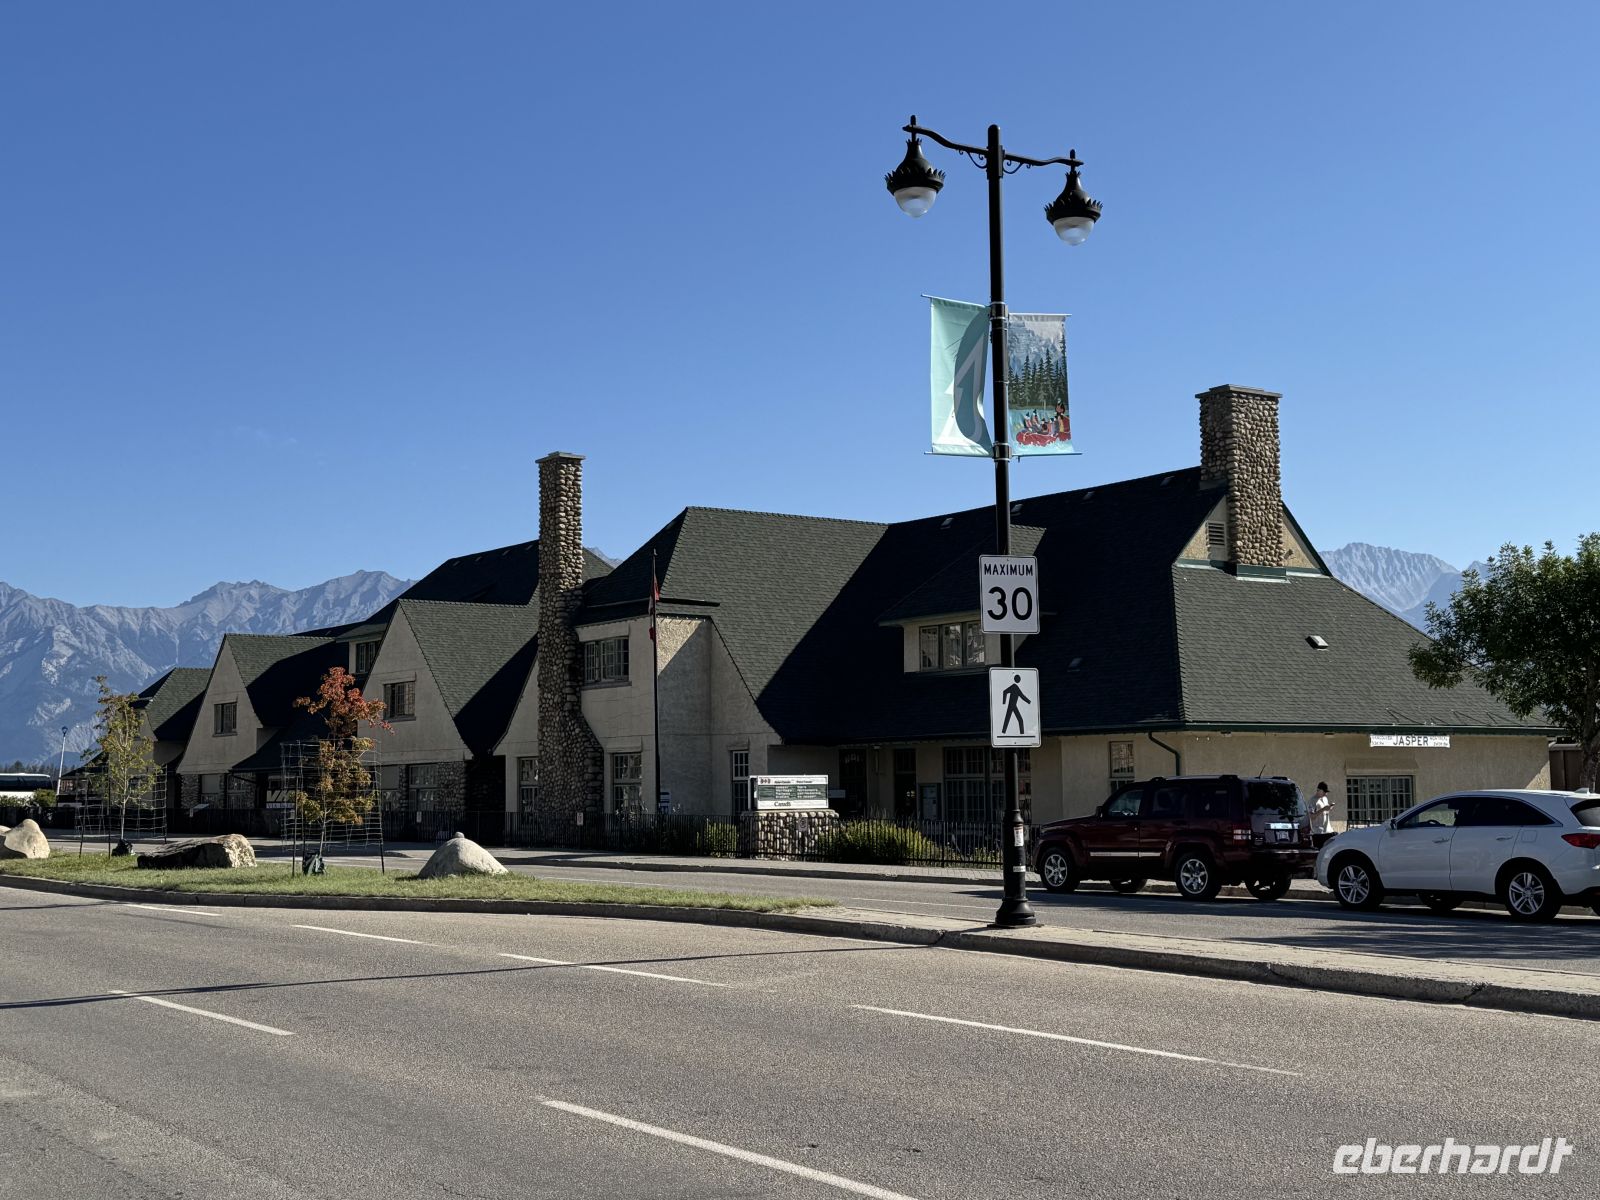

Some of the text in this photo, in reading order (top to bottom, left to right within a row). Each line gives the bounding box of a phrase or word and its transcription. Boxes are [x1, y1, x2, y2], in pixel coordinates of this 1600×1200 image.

[984, 563, 1033, 576] MAXIMUM
[987, 586, 1033, 621] 30
[1393, 735, 1429, 746] JASPER
